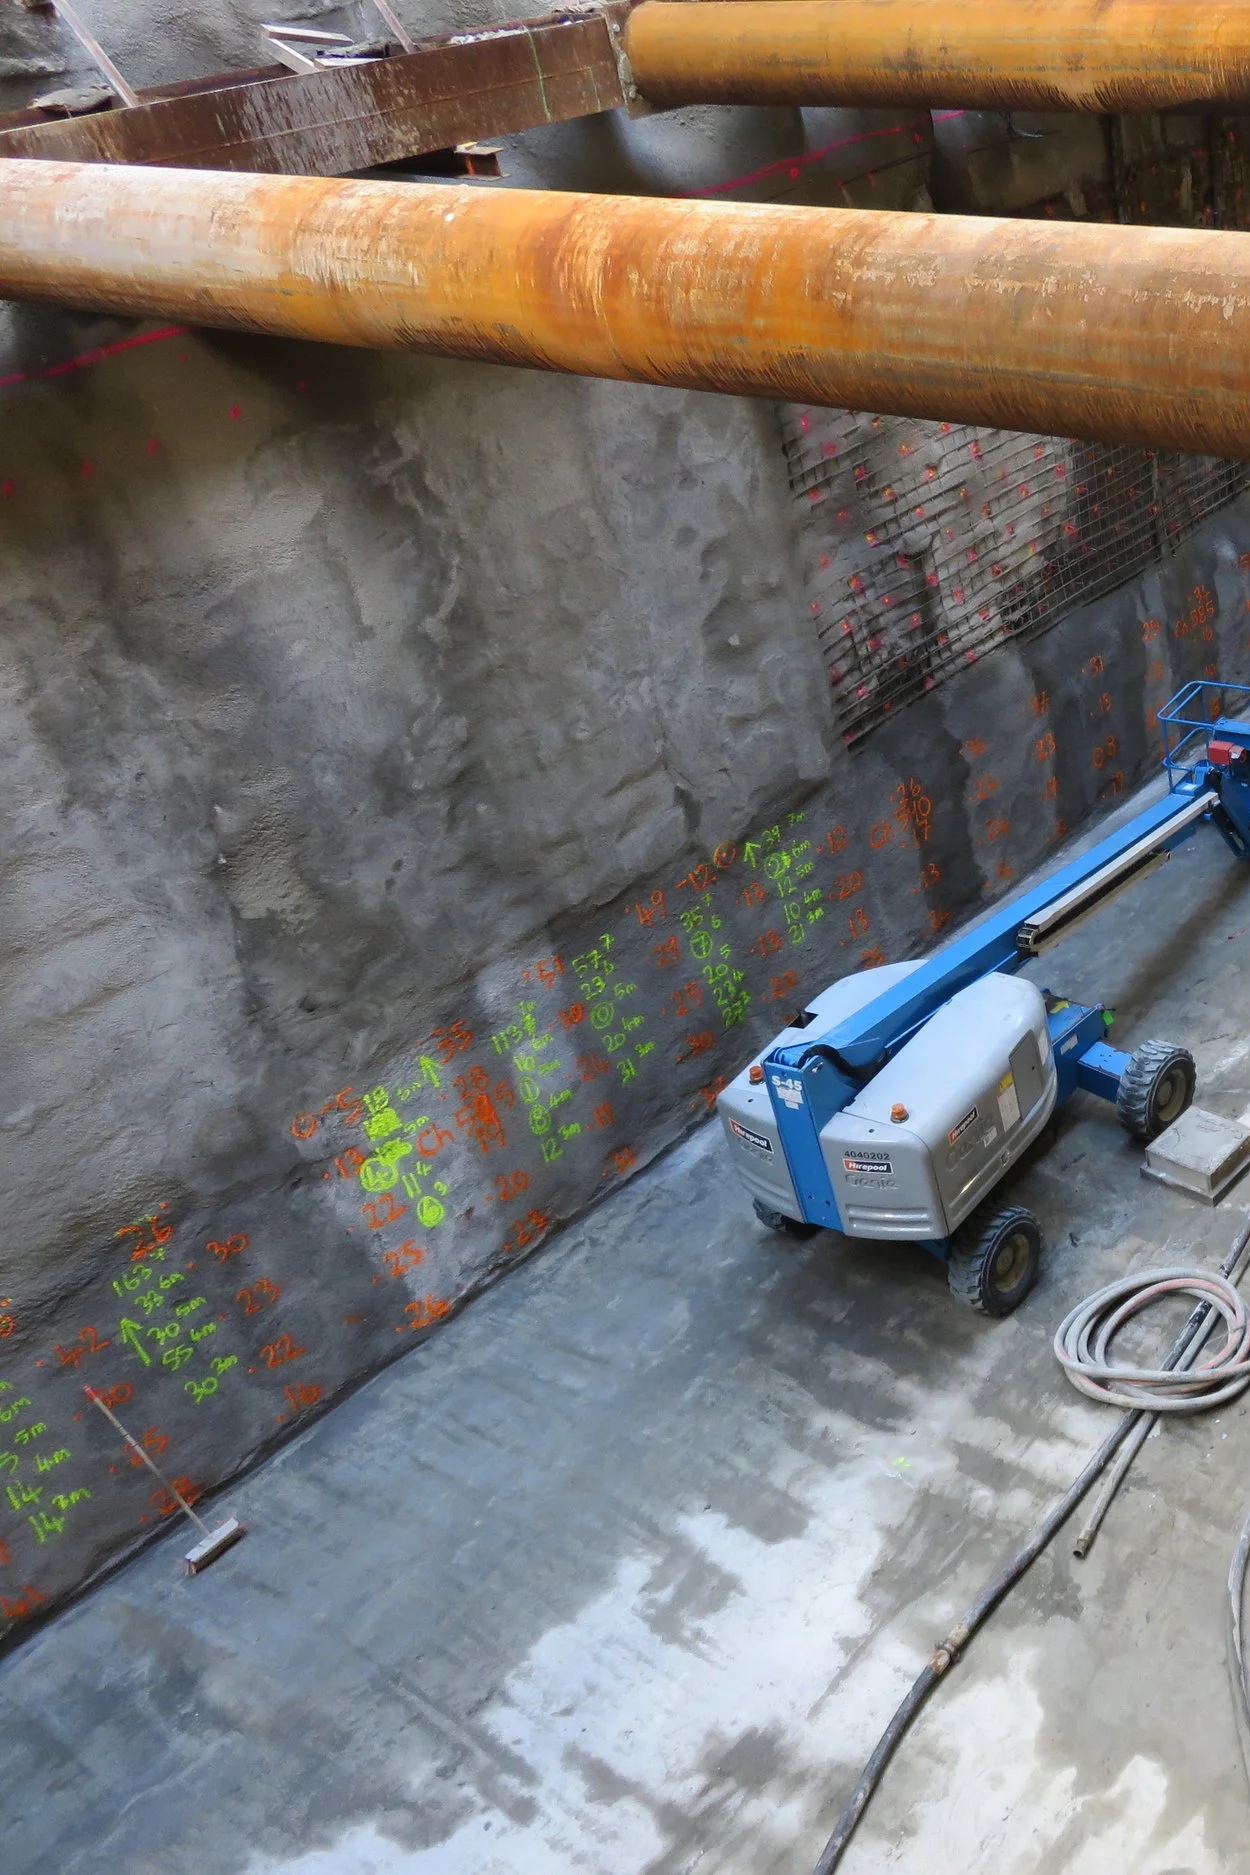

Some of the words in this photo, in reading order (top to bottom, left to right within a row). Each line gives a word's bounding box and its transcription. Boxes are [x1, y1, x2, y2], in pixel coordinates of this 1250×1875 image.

[771, 1075, 803, 1092] S-45
[734, 1124, 768, 1148] Hirepool
[844, 1150, 890, 1161] 4040202
[848, 1162, 888, 1172] Hirepool
